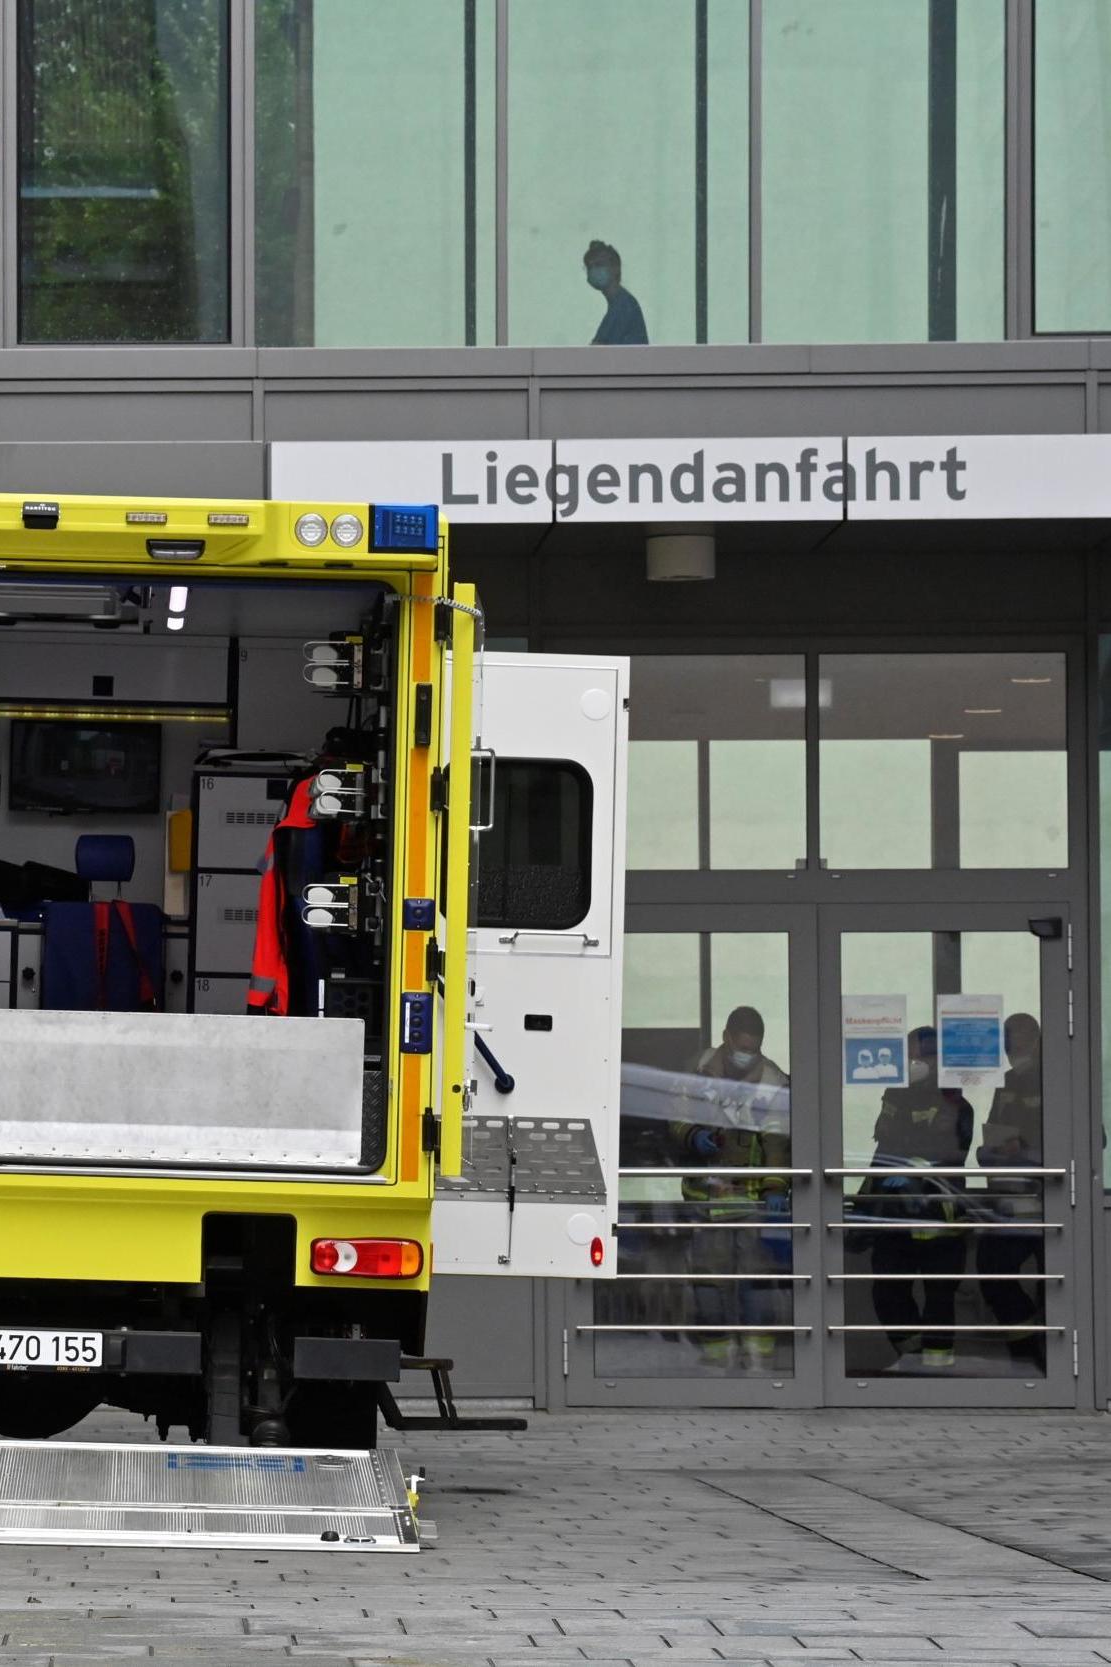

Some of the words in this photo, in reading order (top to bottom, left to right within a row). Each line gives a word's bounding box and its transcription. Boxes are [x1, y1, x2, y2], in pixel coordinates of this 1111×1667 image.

[442, 446, 968, 517] Liegendanfahrt
[201, 777, 214, 790] 16
[199, 874, 212, 888] 17
[196, 978, 210, 992] 18
[51, 1336, 98, 1363] 155
